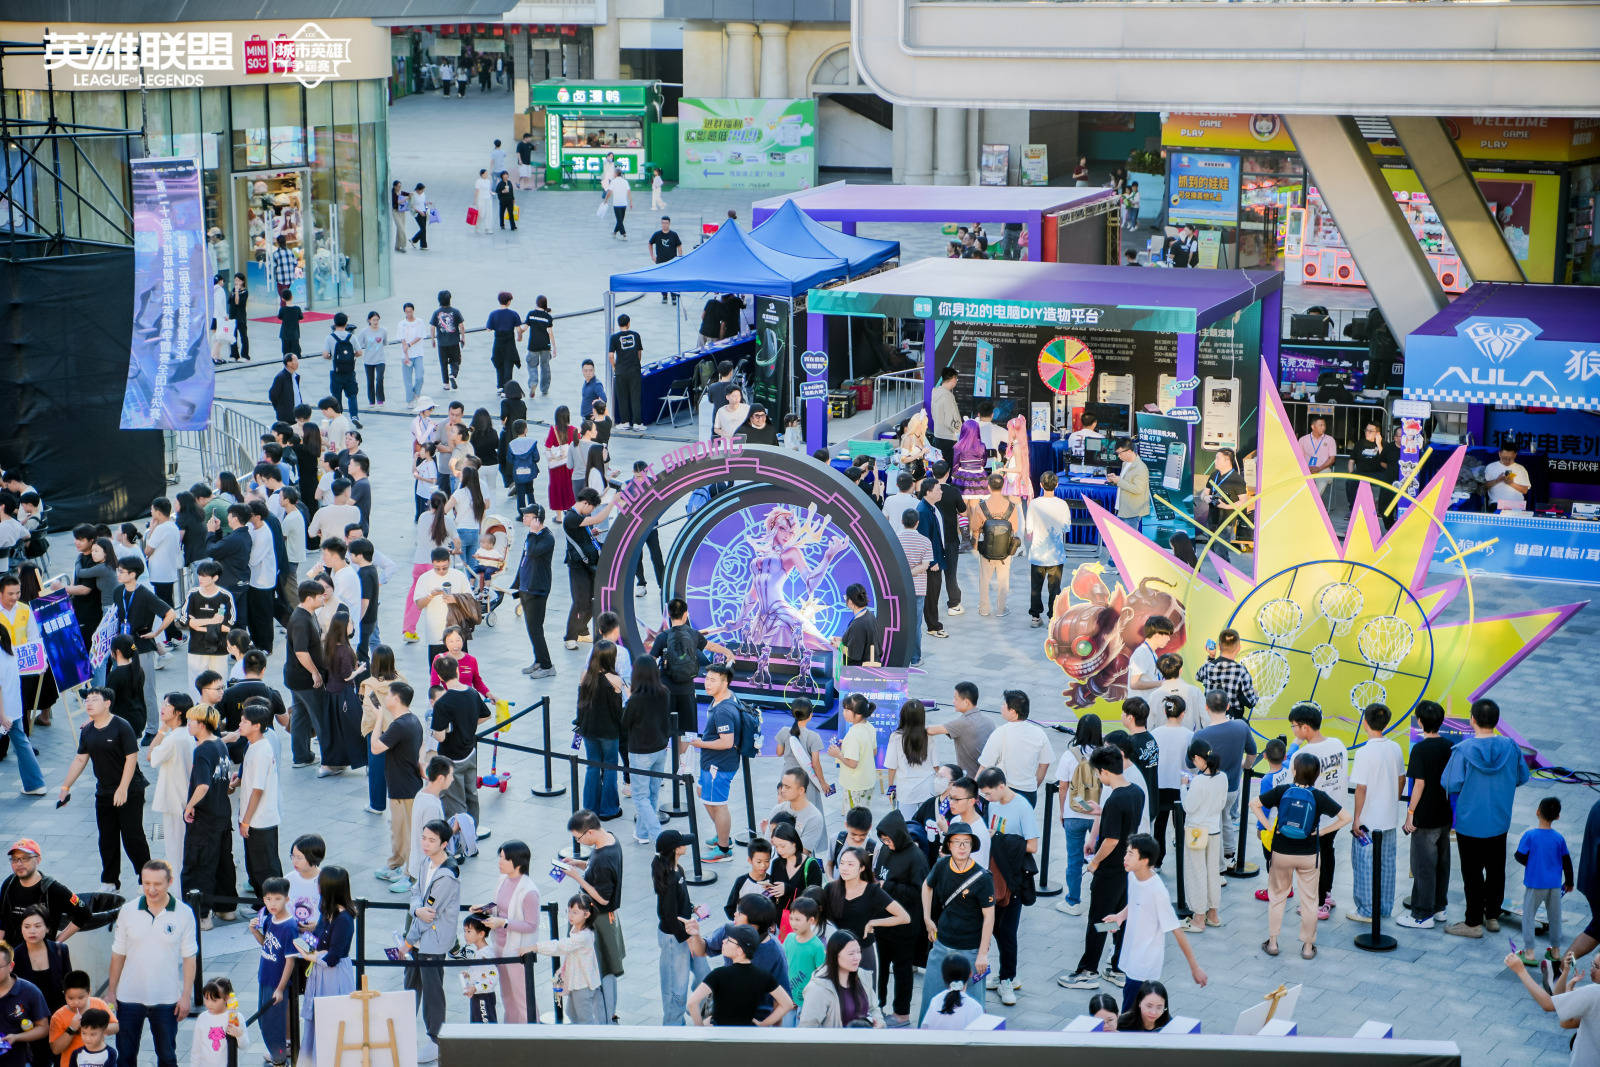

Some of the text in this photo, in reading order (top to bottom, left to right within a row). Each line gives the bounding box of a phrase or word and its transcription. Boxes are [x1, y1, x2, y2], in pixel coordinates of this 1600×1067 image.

[247, 45, 266, 56] MINI
[1200, 120, 1222, 128] GAME
[1472, 116, 1548, 128] WELCOME
[1180, 129, 1204, 137] PLAY
[1178, 175, 1229, 190] 抓到的娃娃
[938, 301, 1099, 324] 你身边的电脑DIY造物平台
[1434, 366, 1557, 393] AULA
[613, 436, 743, 515] LIGHT BINDING
[1325, 769, 1339, 781] 22
